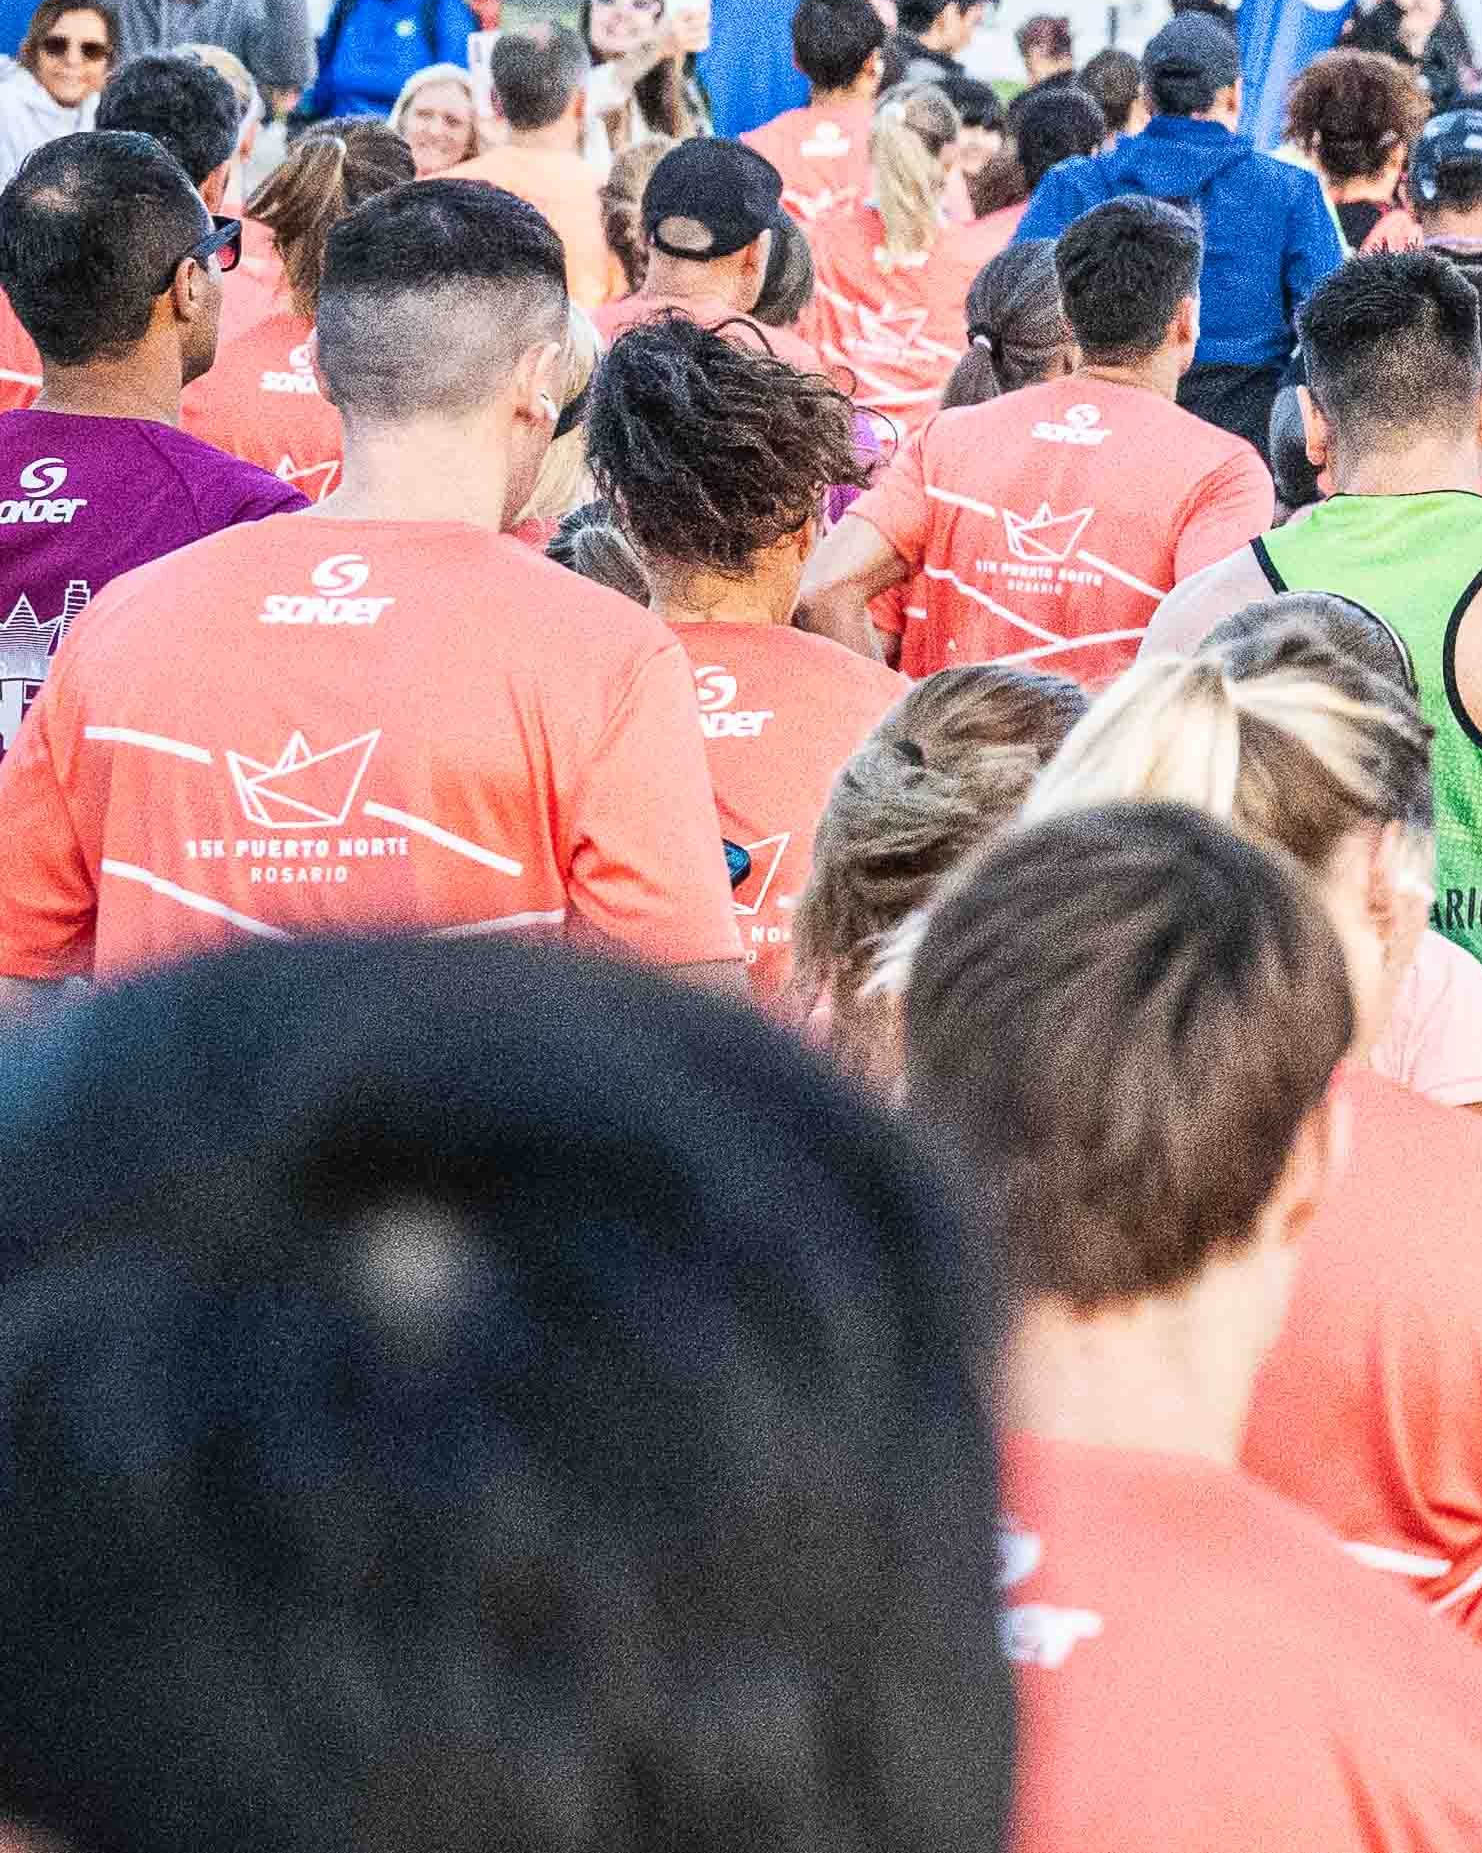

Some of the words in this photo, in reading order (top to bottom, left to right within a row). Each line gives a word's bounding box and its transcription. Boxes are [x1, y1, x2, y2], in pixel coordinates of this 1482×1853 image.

[186, 840, 225, 859] 15K
[235, 838, 329, 859] PUERTO
[338, 836, 408, 857] NORTE
[251, 866, 347, 885] ROSARIO
